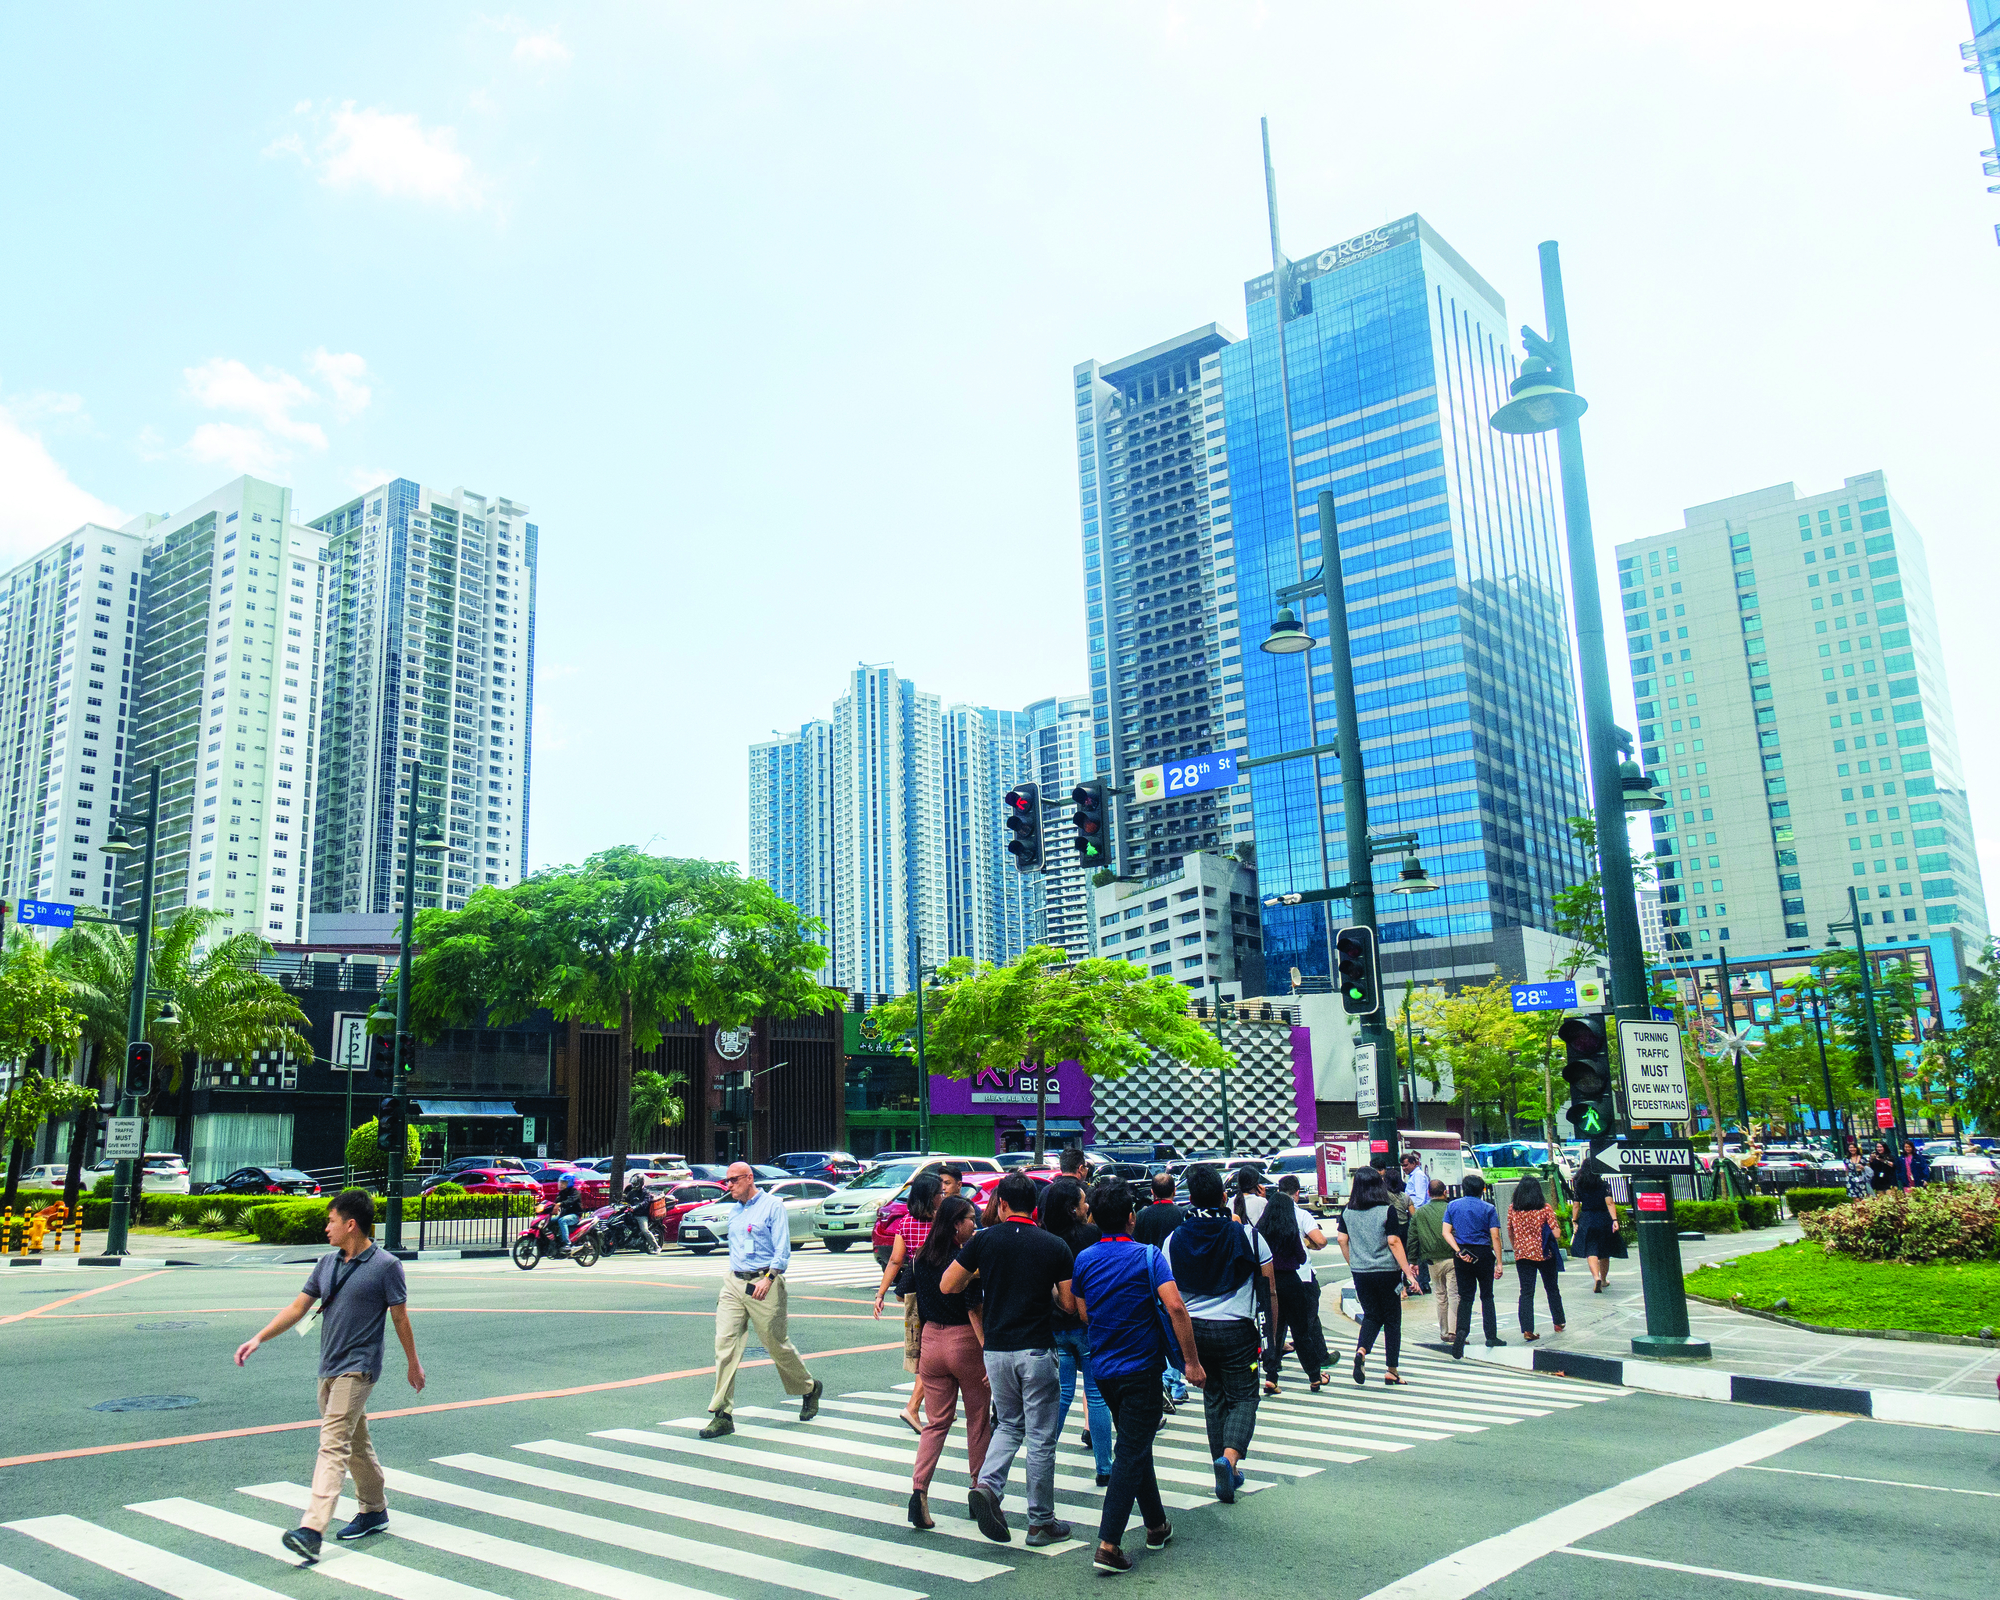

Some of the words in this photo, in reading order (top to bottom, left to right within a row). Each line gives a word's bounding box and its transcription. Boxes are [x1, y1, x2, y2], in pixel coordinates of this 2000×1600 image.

[1338, 226, 1390, 258] RCBC
[1340, 249, 1368, 266] Savings
[1370, 240, 1391, 253] Bank
[1168, 762, 1211, 791] 28th
[1218, 757, 1231, 770] St
[22, 904, 48, 920] 5th
[54, 907, 72, 917] Ave
[1515, 989, 1548, 1007] 28th
[1565, 987, 1575, 995] St
[1634, 1032, 1669, 1042] TURNING
[1637, 1048, 1670, 1058] TRAFFIC
[1641, 1065, 1668, 1077] MUST
[1632, 1083, 1651, 1093] GIVE
[1653, 1084, 1670, 1094] WAY
[1672, 1084, 1683, 1093] TO
[1022, 1094, 1035, 1102] YOU
[1633, 1100, 1687, 1110] PEDESTRIANS
[1620, 1150, 1651, 1164] ONE
[1655, 1150, 1686, 1164] WAY
